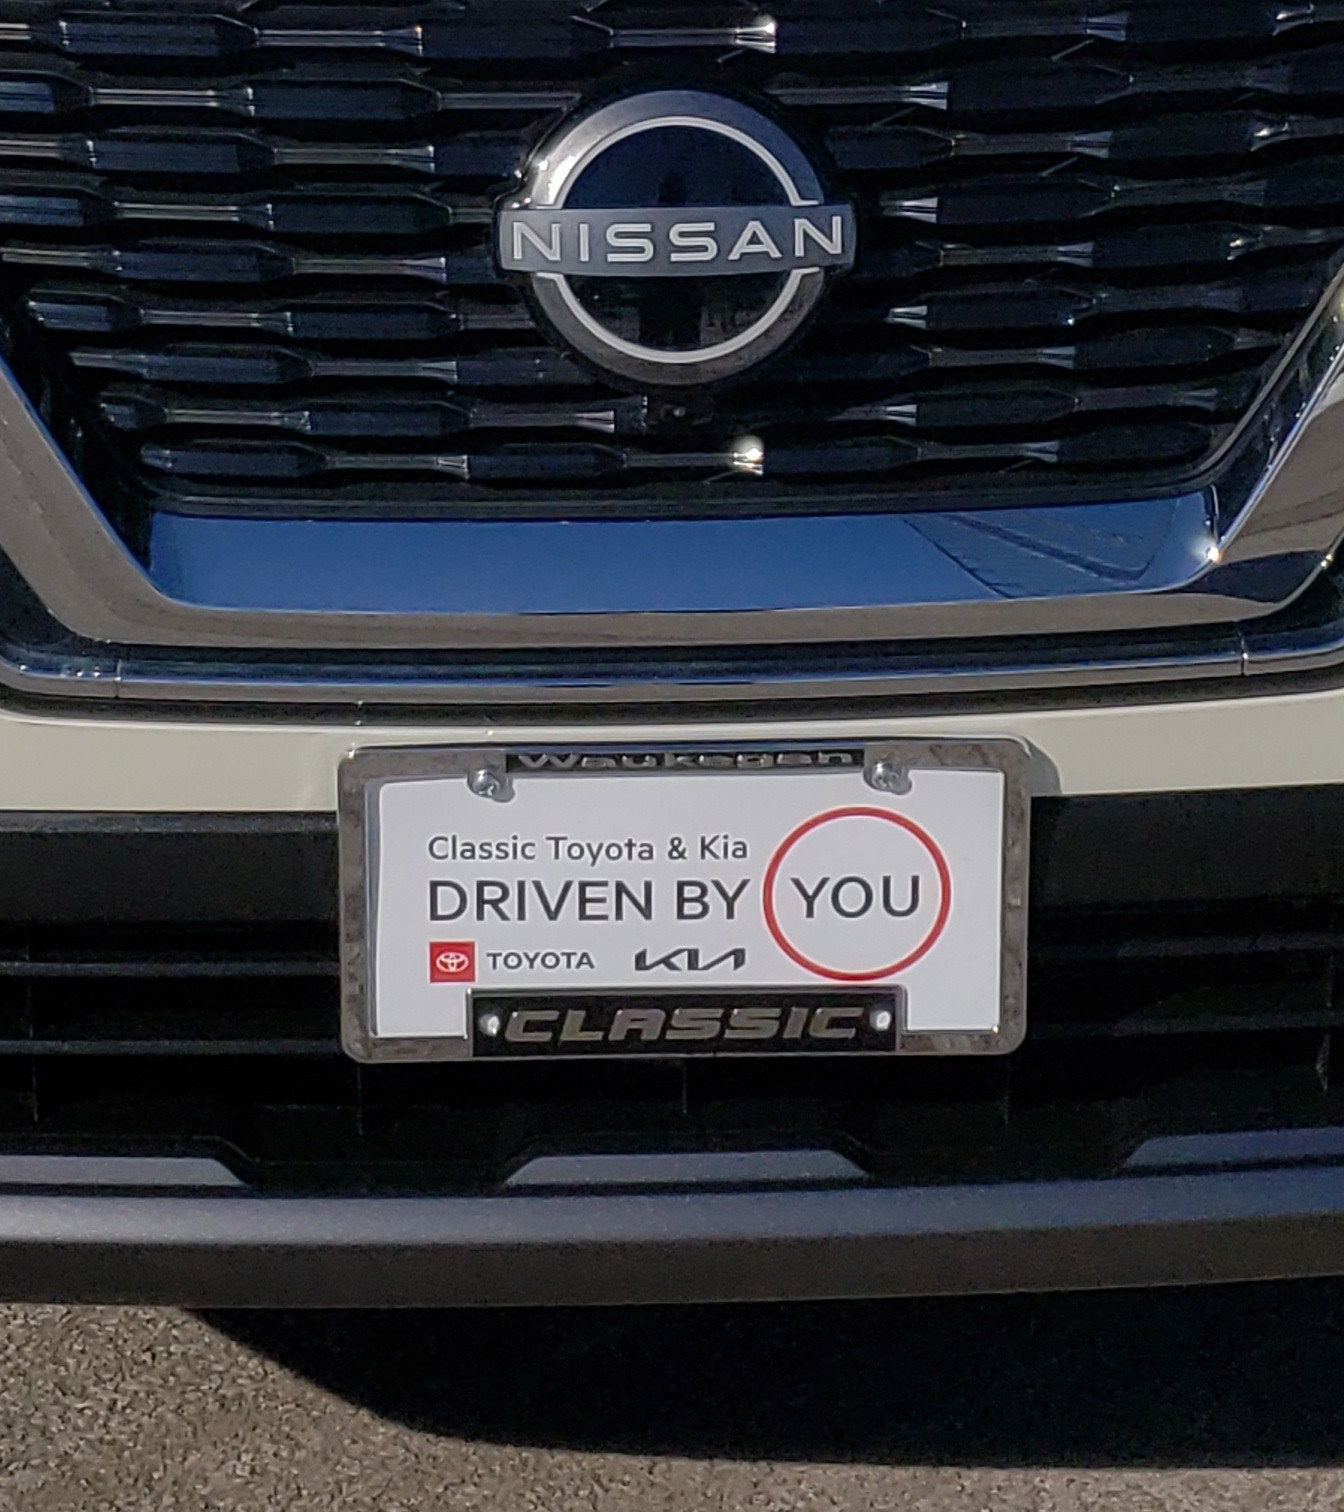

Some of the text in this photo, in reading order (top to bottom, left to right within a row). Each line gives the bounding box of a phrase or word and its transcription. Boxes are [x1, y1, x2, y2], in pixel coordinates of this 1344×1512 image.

[512, 216, 843, 263] NISSAN
[428, 834, 748, 866] Classic Toyota & Kia
[429, 875, 920, 921] DRIVEN BY YOU
[486, 951, 595, 970] TOYOTA
[504, 1007, 864, 1043] CLASSIC
